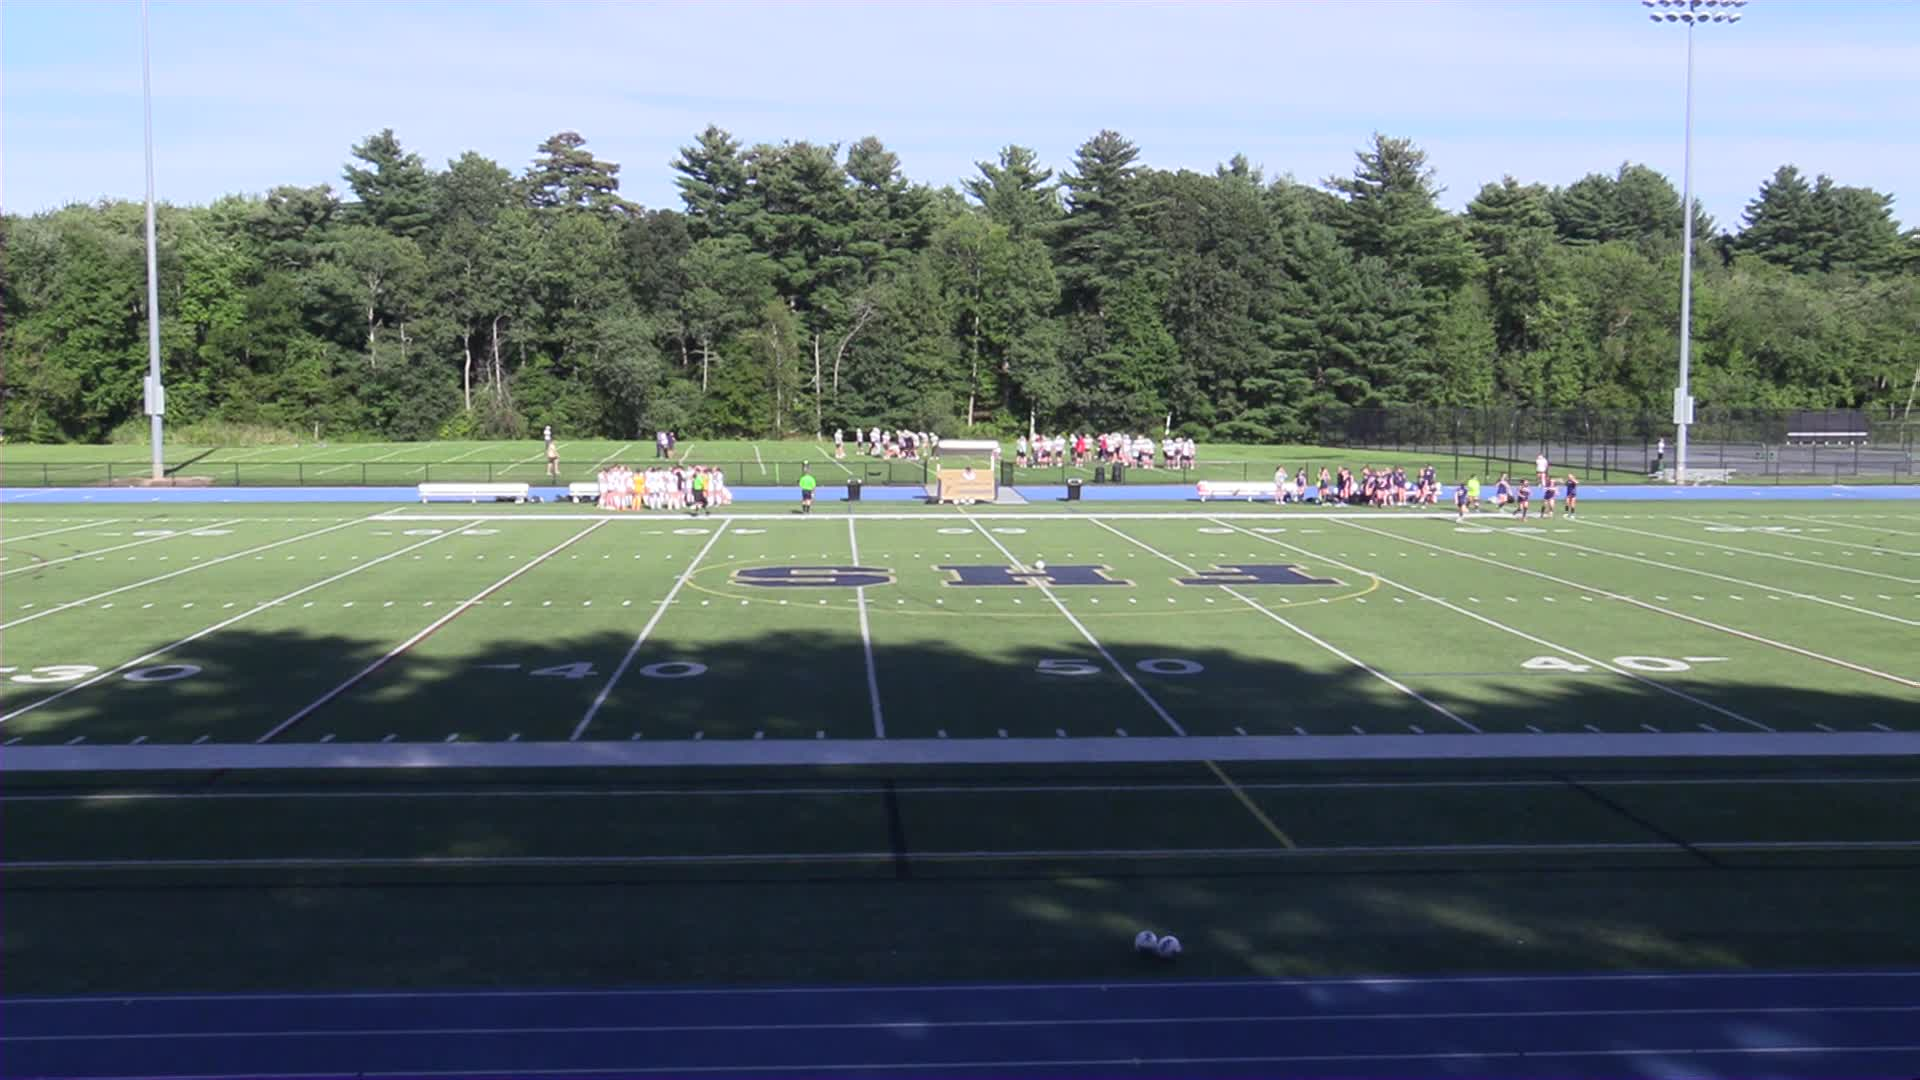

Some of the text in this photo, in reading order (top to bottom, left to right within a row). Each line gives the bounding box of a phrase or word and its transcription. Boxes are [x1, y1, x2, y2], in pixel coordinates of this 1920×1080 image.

[529, 661, 708, 679] 40
[1035, 658, 1204, 675] 50
[1520, 656, 1691, 672] 40
[10, 664, 202, 683] 30
